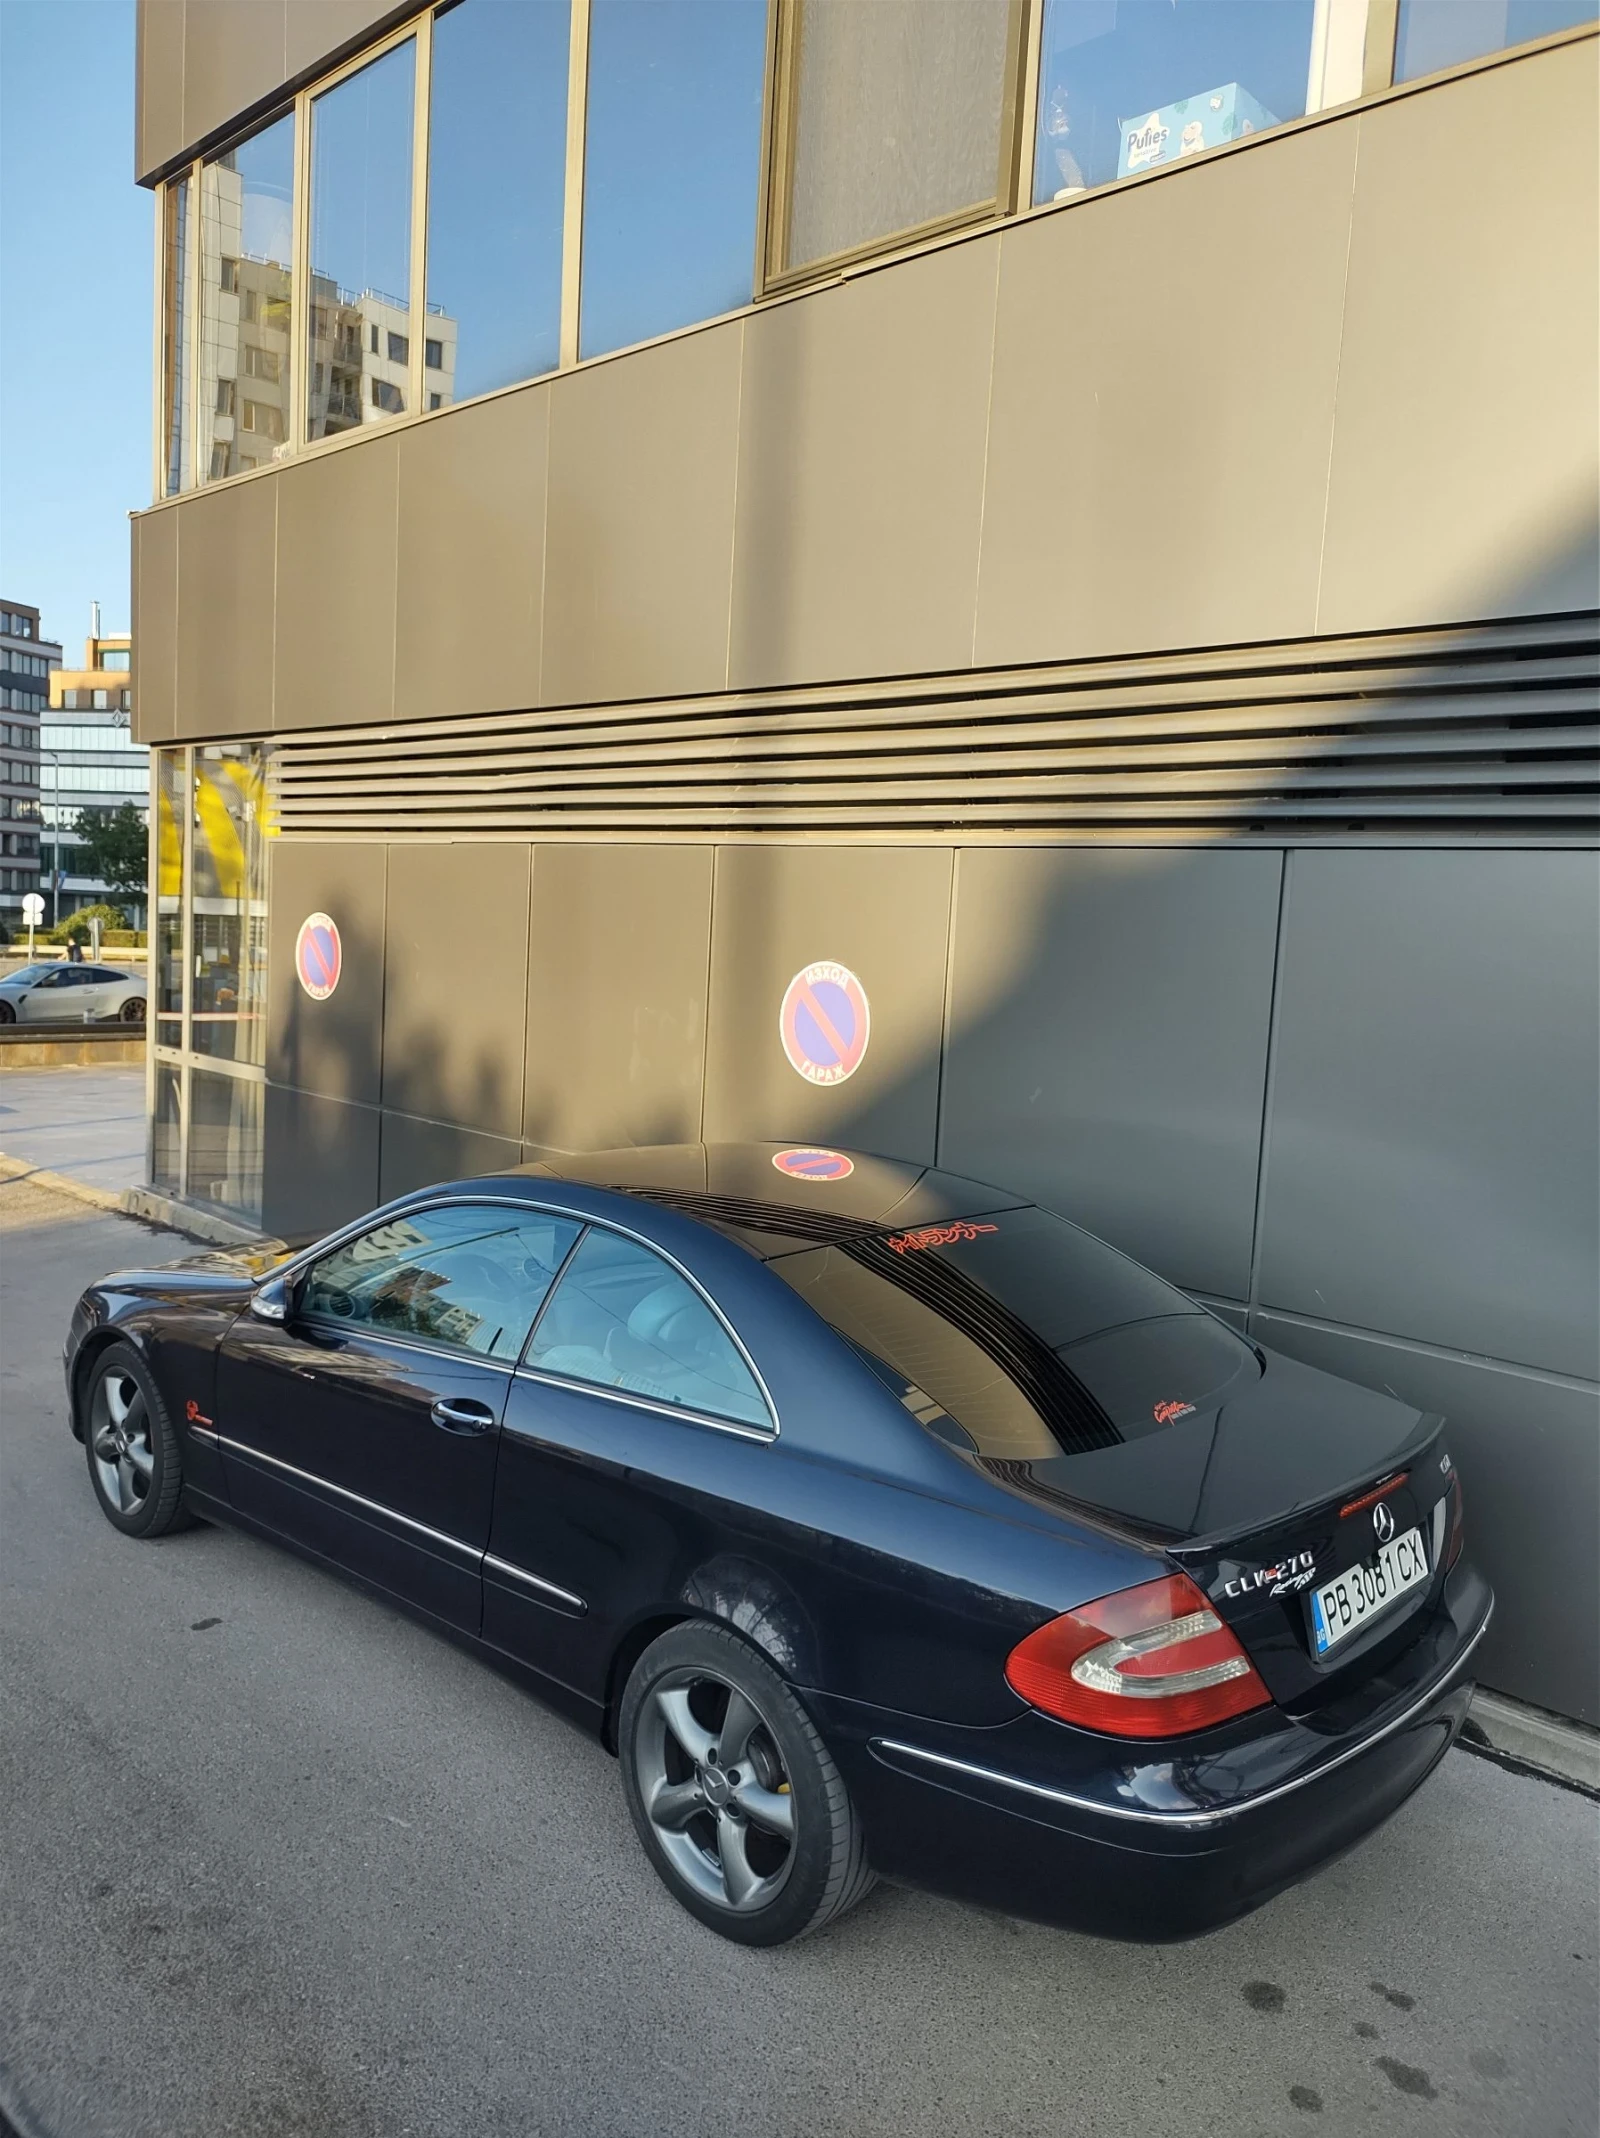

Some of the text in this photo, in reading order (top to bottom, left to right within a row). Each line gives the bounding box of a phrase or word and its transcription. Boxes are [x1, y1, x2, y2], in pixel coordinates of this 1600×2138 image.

[1128, 127, 1167, 153] Pufies
[805, 966, 849, 990] ИЗХОД
[801, 1061, 846, 1082] ГАРАЖ
[1322, 1533, 1424, 1636] PB 3081 CX
